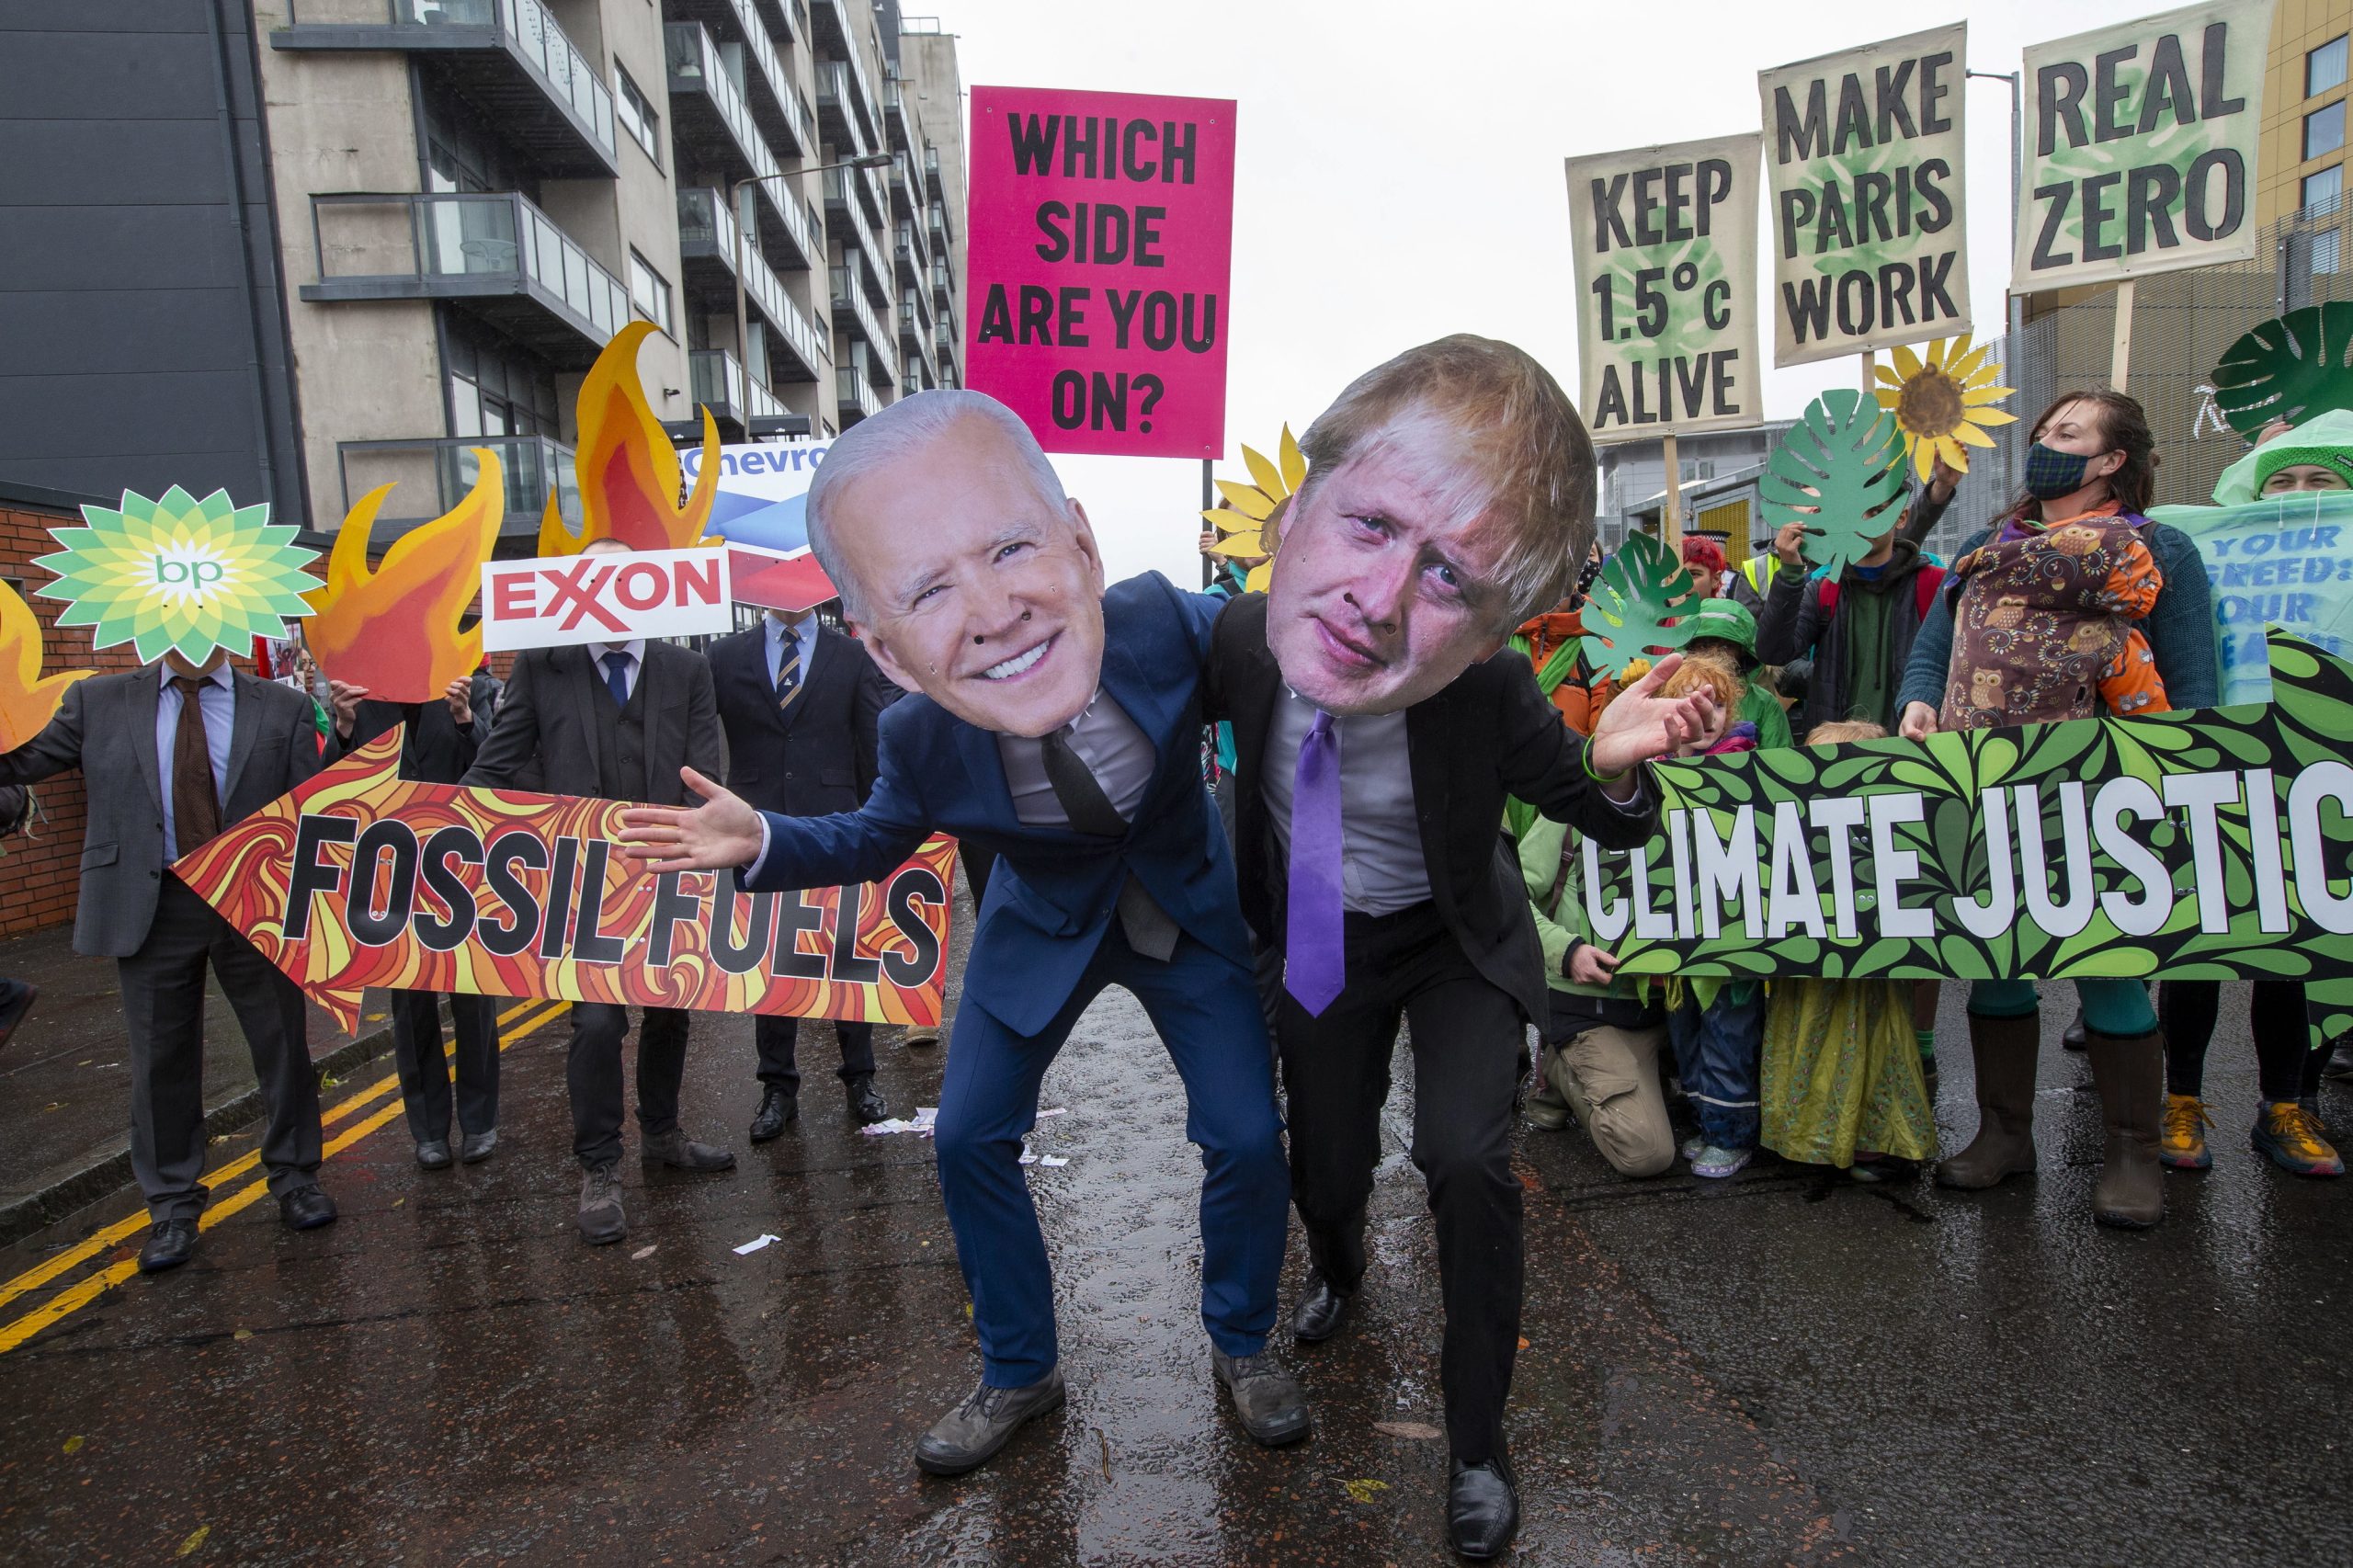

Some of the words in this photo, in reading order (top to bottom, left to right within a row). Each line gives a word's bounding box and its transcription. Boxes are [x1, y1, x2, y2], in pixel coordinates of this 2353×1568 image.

[1775, 51, 1952, 165] MAKE
[2038, 22, 2245, 157] REAL
[1007, 112, 1197, 184] WHICH
[1035, 200, 1165, 267] SIDE
[1591, 158, 1732, 253] KEEP
[1779, 158, 1952, 259] PARIS
[2031, 148, 2245, 271] ZERO
[977, 284, 1090, 347] ARE
[1105, 289, 1216, 354] YOU
[1782, 251, 1960, 345] WORK
[1051, 369, 1165, 434] ON?
[1594, 348, 1740, 429] ALIVE
[155, 555, 223, 588] bp
[2211, 526, 2342, 557] YOUR
[493, 558, 721, 632] EXXON
[1581, 791, 1936, 941] CLIMATE
[1952, 761, 2353, 938] JUSTIC
[282, 813, 626, 964] FOSSIL
[646, 859, 945, 988] FUELS
